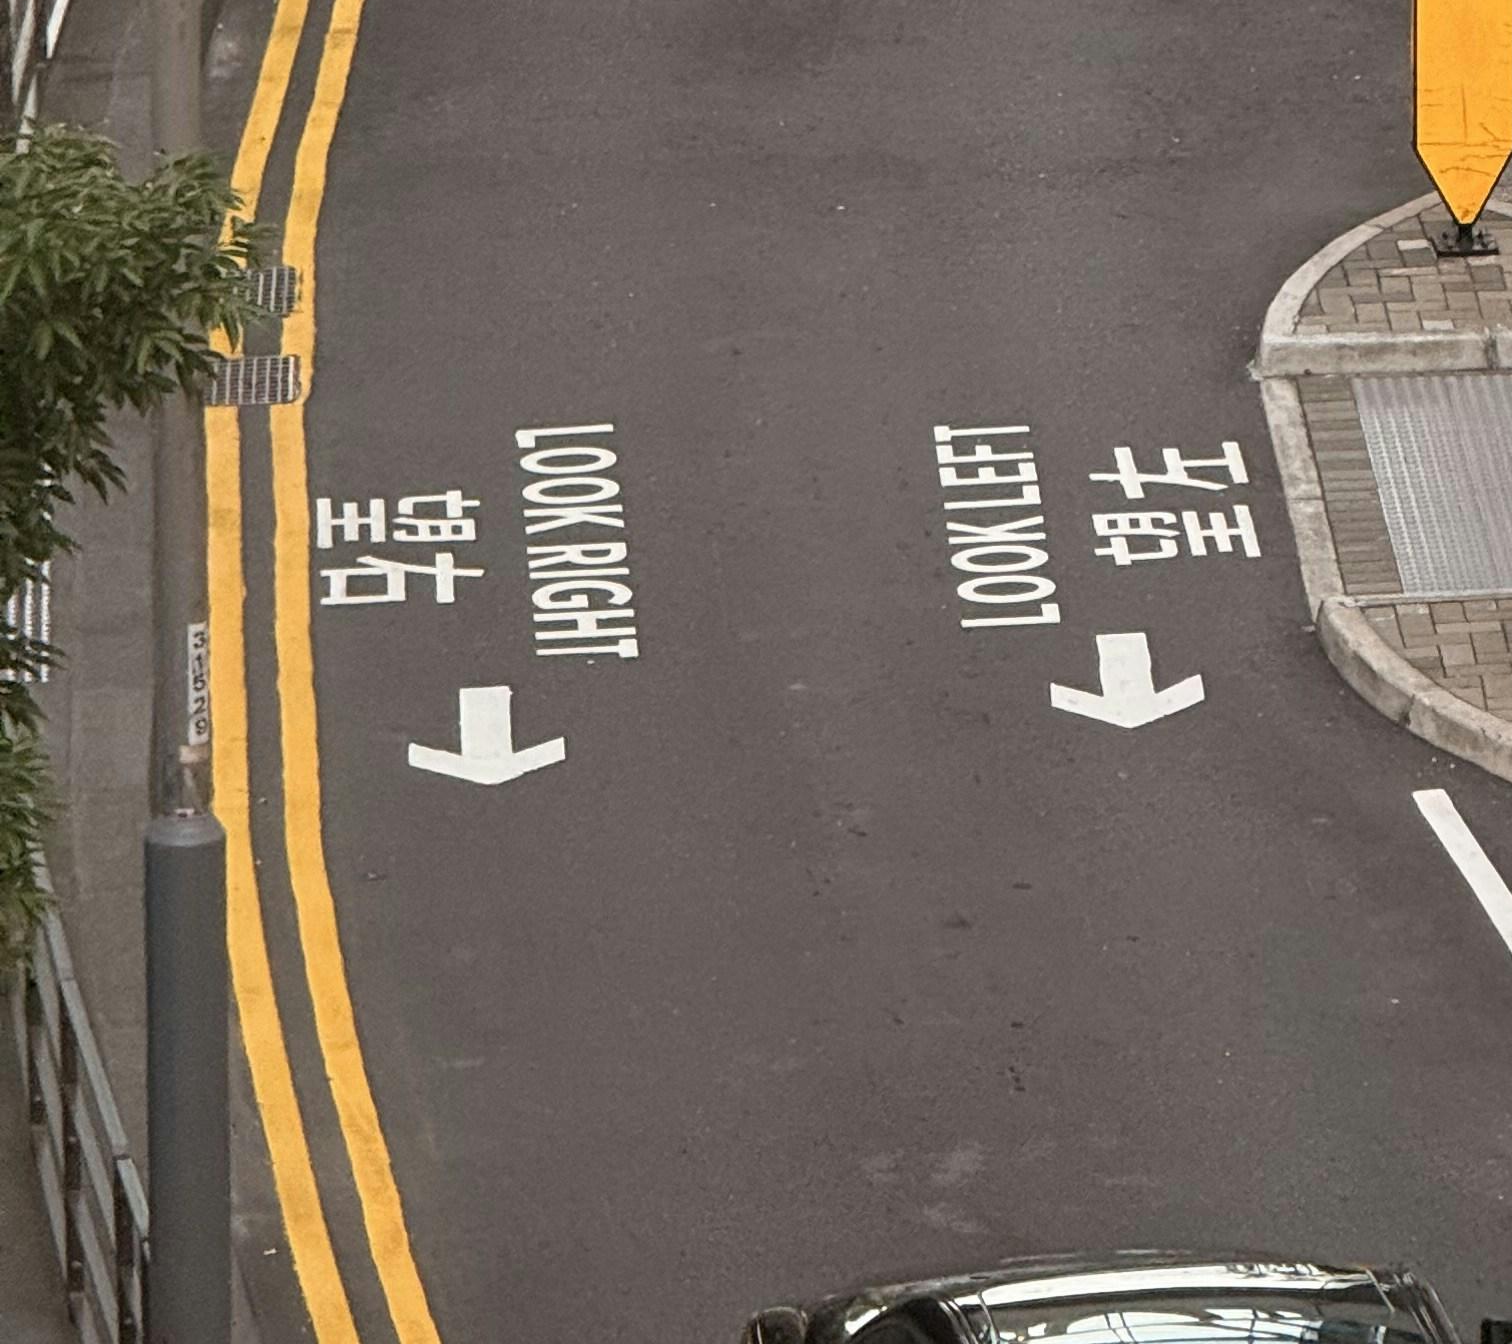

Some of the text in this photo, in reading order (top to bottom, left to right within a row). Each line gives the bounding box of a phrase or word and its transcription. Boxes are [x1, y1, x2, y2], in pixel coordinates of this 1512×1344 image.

[316, 490, 485, 606] 望右
[515, 424, 639, 658] LOOK RIGHT
[933, 425, 1060, 628] LOOK LEFT
[1089, 441, 1262, 566] 望左
[193, 631, 207, 735] 31529
